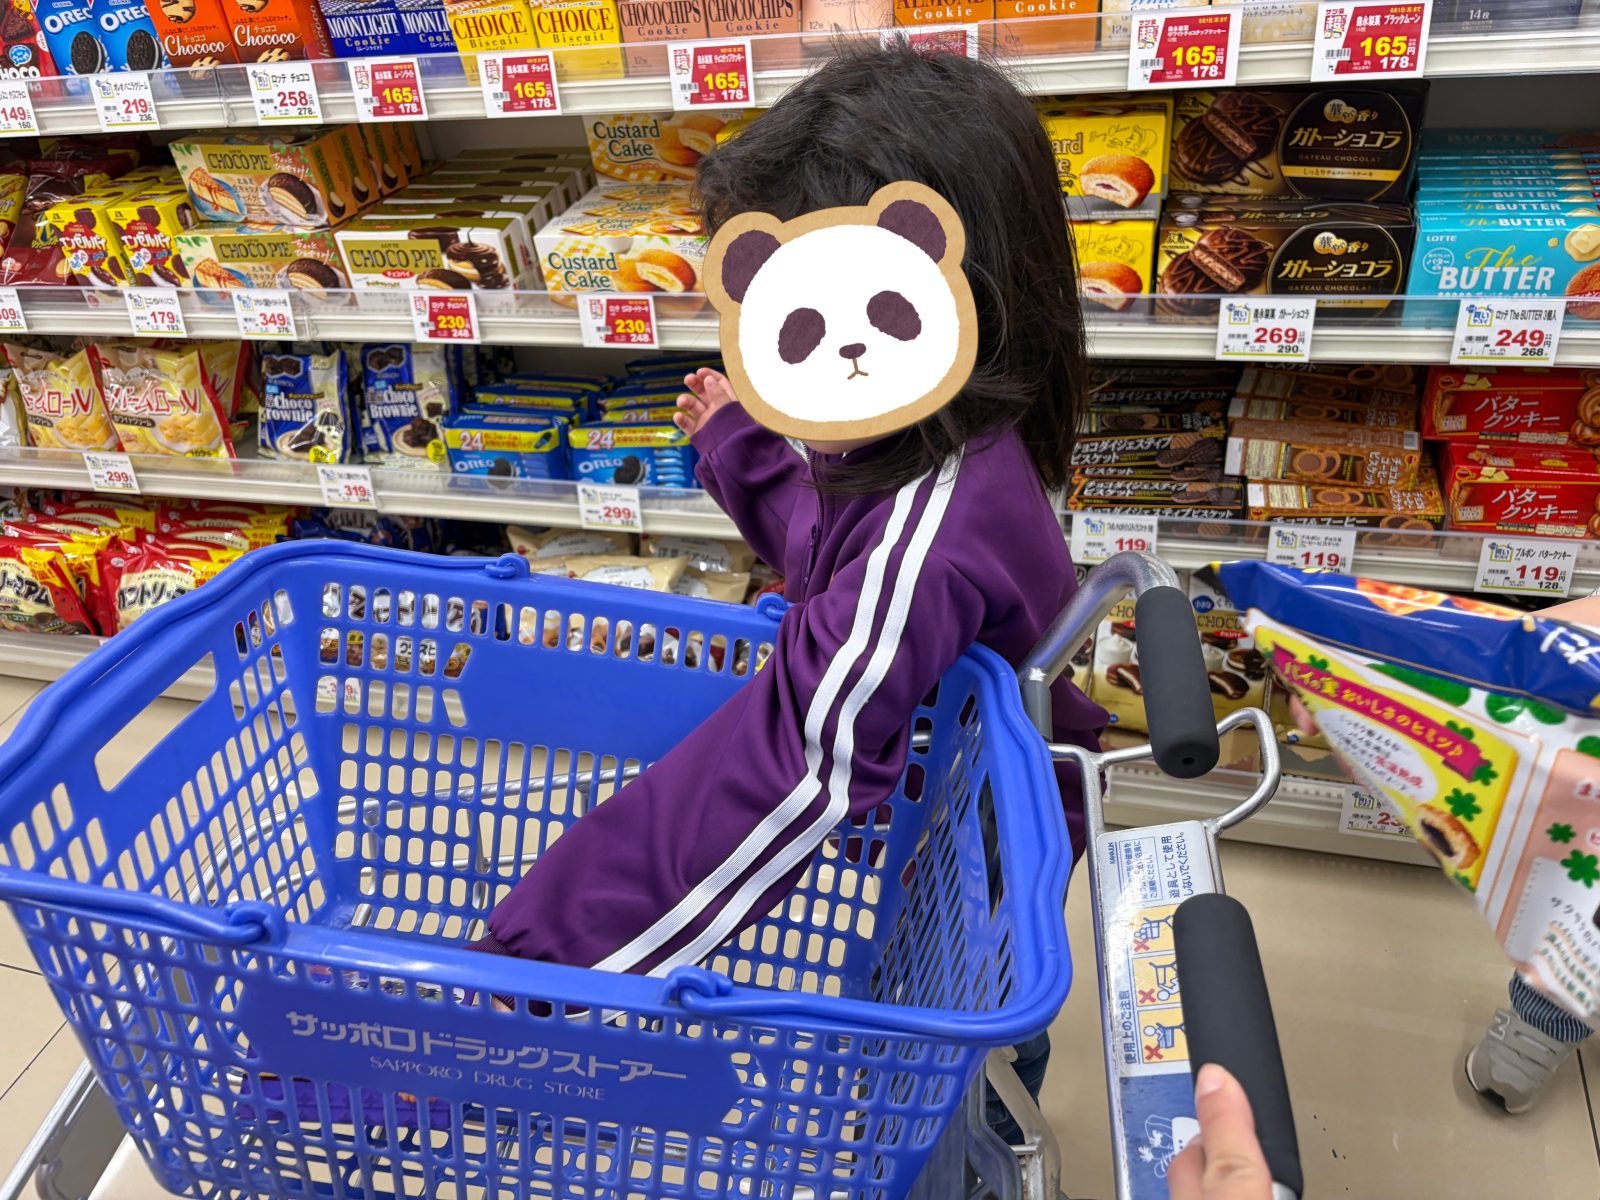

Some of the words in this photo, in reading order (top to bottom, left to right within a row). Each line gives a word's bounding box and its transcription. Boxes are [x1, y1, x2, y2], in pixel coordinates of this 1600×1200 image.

[620, 0, 702, 27] CHOCOCHIPS
[708, 0, 793, 23] CHOCOCHIPS
[913, 8, 972, 20] Cookie
[1015, 1, 1076, 13] Cookie
[326, 13, 399, 38] MOONLIGHT
[400, 10, 450, 34] MOONLI
[453, 11, 528, 40] CHOICE
[537, 8, 614, 35] CHOICE
[725, 21, 780, 33] Cookie
[1384, 14, 1421, 24] ブラックムーン
[234, 24, 304, 47] Chococo
[419, 33, 451, 43] Cook
[553, 32, 605, 44] Biscuit
[637, 25, 688, 37] Cookie
[165, 35, 231, 57] Chococo
[345, 37, 390, 47] Cookie
[470, 36, 519, 49] Biscuit
[1360, 36, 1408, 56] 165
[1172, 45, 1216, 66] 165
[1380, 56, 1409, 69] 178
[531, 64, 549, 72] チョイス
[1191, 65, 1218, 78] 178
[272, 75, 286, 83] ロッテ
[290, 73, 310, 82] チョココ
[704, 72, 739, 90] 165
[382, 87, 413, 103] 165
[514, 82, 546, 98] 165
[721, 89, 743, 100] 178
[122, 98, 148, 114] 219
[277, 90, 309, 107] 258
[531, 98, 551, 108] 178
[1, 106, 26, 121] 149
[297, 107, 313, 115] 278
[399, 103, 418, 113] 178
[592, 119, 660, 140] Custard
[1288, 127, 1404, 150] ガトーショコラ
[608, 140, 654, 157] Cake
[208, 153, 250, 173] CHOCO
[251, 154, 272, 171] PIE
[1499, 218, 1567, 227] BUTTER
[219, 242, 269, 260] CHOCO
[271, 241, 292, 258] PIE
[350, 249, 410, 268] CHOCO
[410, 250, 441, 268] PIE
[1465, 245, 1543, 272] The
[548, 252, 619, 271] Custard
[1277, 259, 1394, 279] ガトーショコラ
[564, 271, 612, 289] Cake
[1438, 267, 1555, 290] BUTTER
[150, 311, 175, 324] 179
[259, 313, 286, 326] 349
[437, 315, 465, 329] 230
[1279, 309, 1310, 319] ガトーショコラ
[1496, 310, 1508, 320] ロッテ
[1510, 310, 1519, 320] The
[1520, 310, 1542, 320] BUTTER
[615, 319, 645, 333] 230
[1253, 327, 1298, 344] 269
[1495, 329, 1545, 347] 249
[1277, 345, 1299, 353] 290
[1521, 348, 1544, 356] 268
[275, 392, 313, 409] Choco
[384, 385, 415, 404] Choco
[371, 403, 418, 418] Brownie
[1475, 396, 1539, 412] バター
[266, 408, 313, 422] rownie
[1484, 411, 1560, 429] クッキー
[459, 431, 484, 451] 24
[586, 430, 615, 450] 24
[579, 459, 624, 474] OREO
[1071, 453, 1120, 465] ビスケット
[106, 471, 128, 482] 299
[1084, 467, 1134, 476] ビスケット
[344, 485, 368, 496] 319
[1083, 488, 1134, 497] ビスケット
[1492, 488, 1557, 504] バター
[603, 506, 632, 518] 299
[1501, 504, 1578, 520] クッキー
[1115, 537, 1146, 551] 119
[1301, 551, 1339, 567] 119
[1515, 548, 1535, 557] ブルボン
[1538, 549, 1571, 560] バタークッキー
[1516, 565, 1559, 581] 119
[1538, 581, 1559, 589] 128
[1161, 835, 1180, 898] 遊具として使用
[1176, 832, 1194, 896] しないでください。
[1119, 990, 1137, 1064] 使用上のご注意
[285, 1011, 687, 1082] サッポロドラッグストアー
[370, 1056, 463, 1080] SAPPORO
[473, 1071, 533, 1090] DRUG
[544, 1081, 606, 1101] STORE
